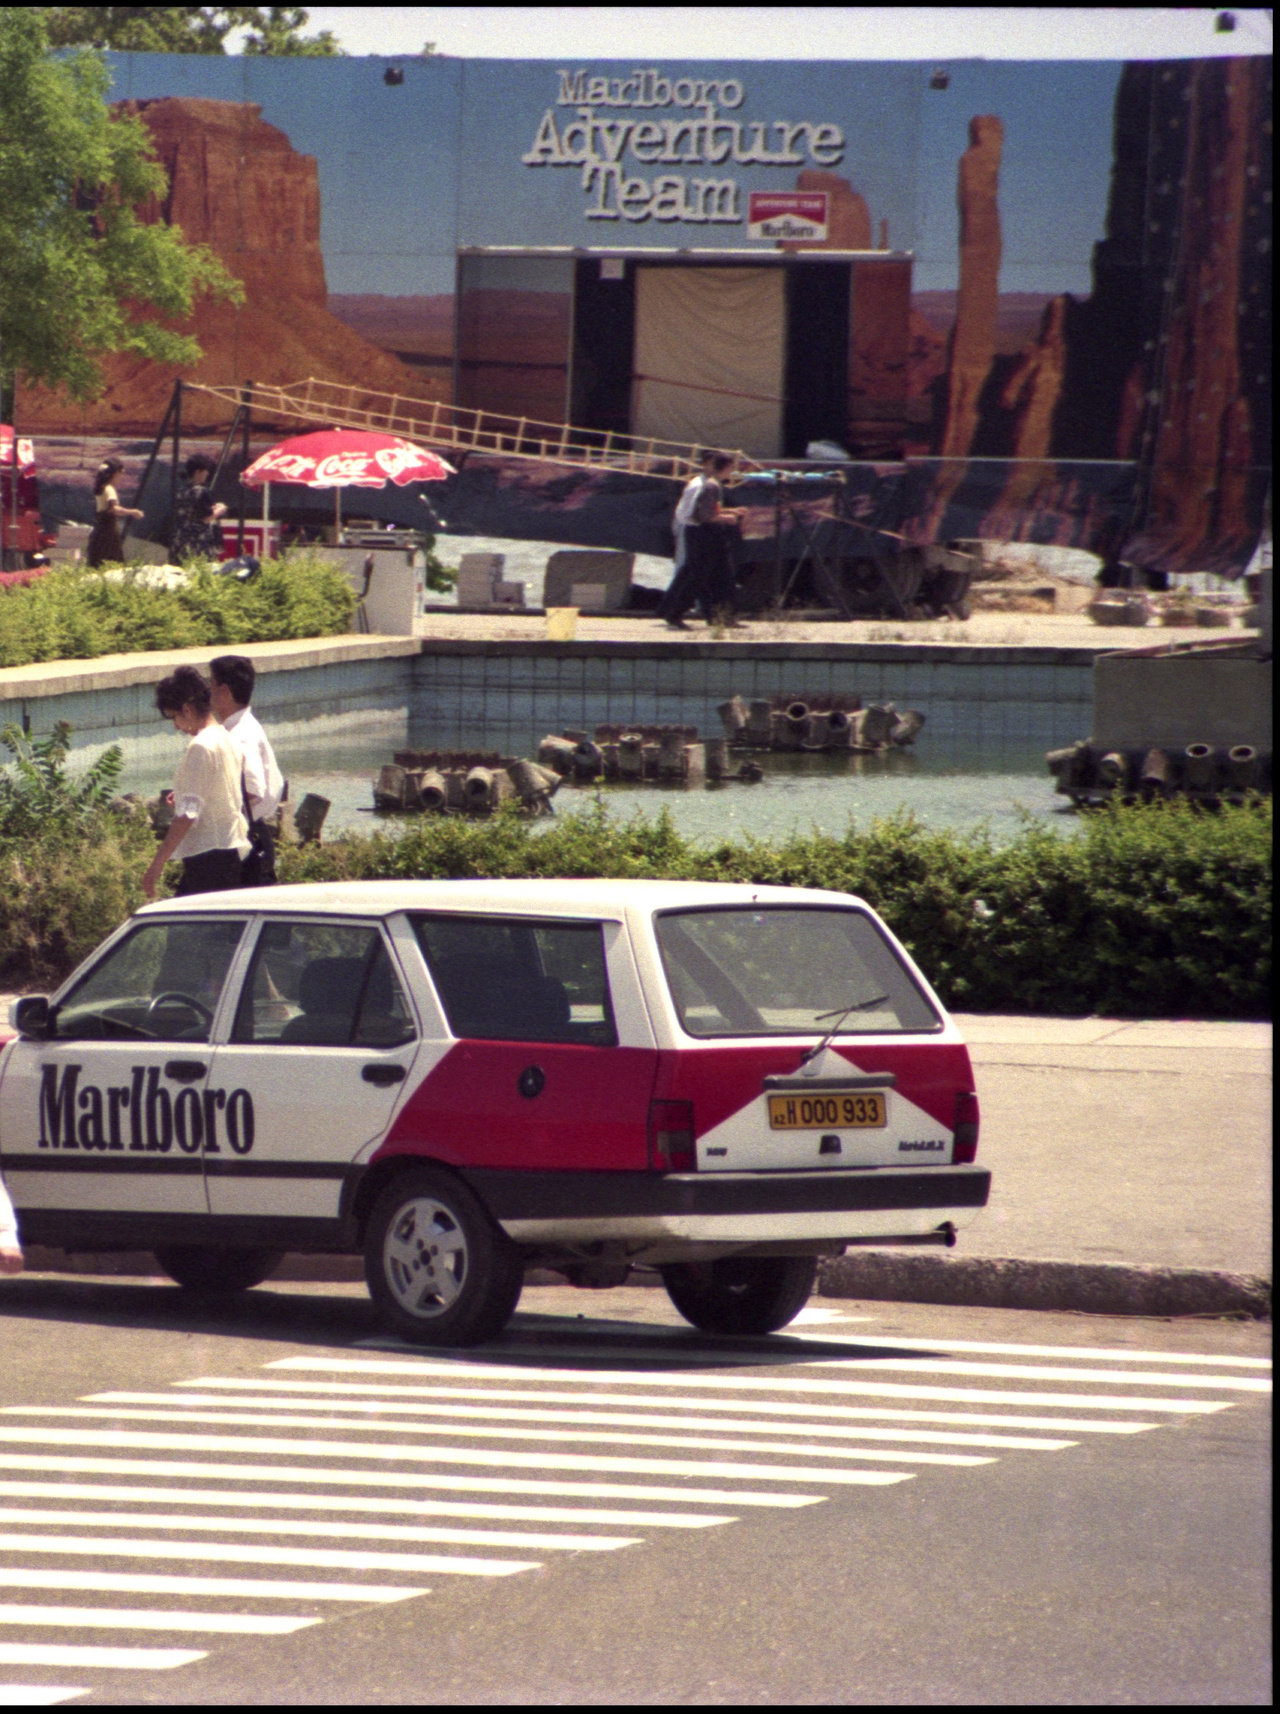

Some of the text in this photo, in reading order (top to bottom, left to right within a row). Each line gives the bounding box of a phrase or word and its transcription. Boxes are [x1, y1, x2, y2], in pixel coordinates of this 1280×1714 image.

[556, 69, 744, 109] Marlboro
[522, 104, 845, 164] Adventure
[581, 160, 742, 222] Team
[761, 220, 815, 237] Marlboro
[38, 1063, 255, 1154] Marlboro
[787, 1100, 797, 1124] H
[842, 1098, 880, 1123] 933
